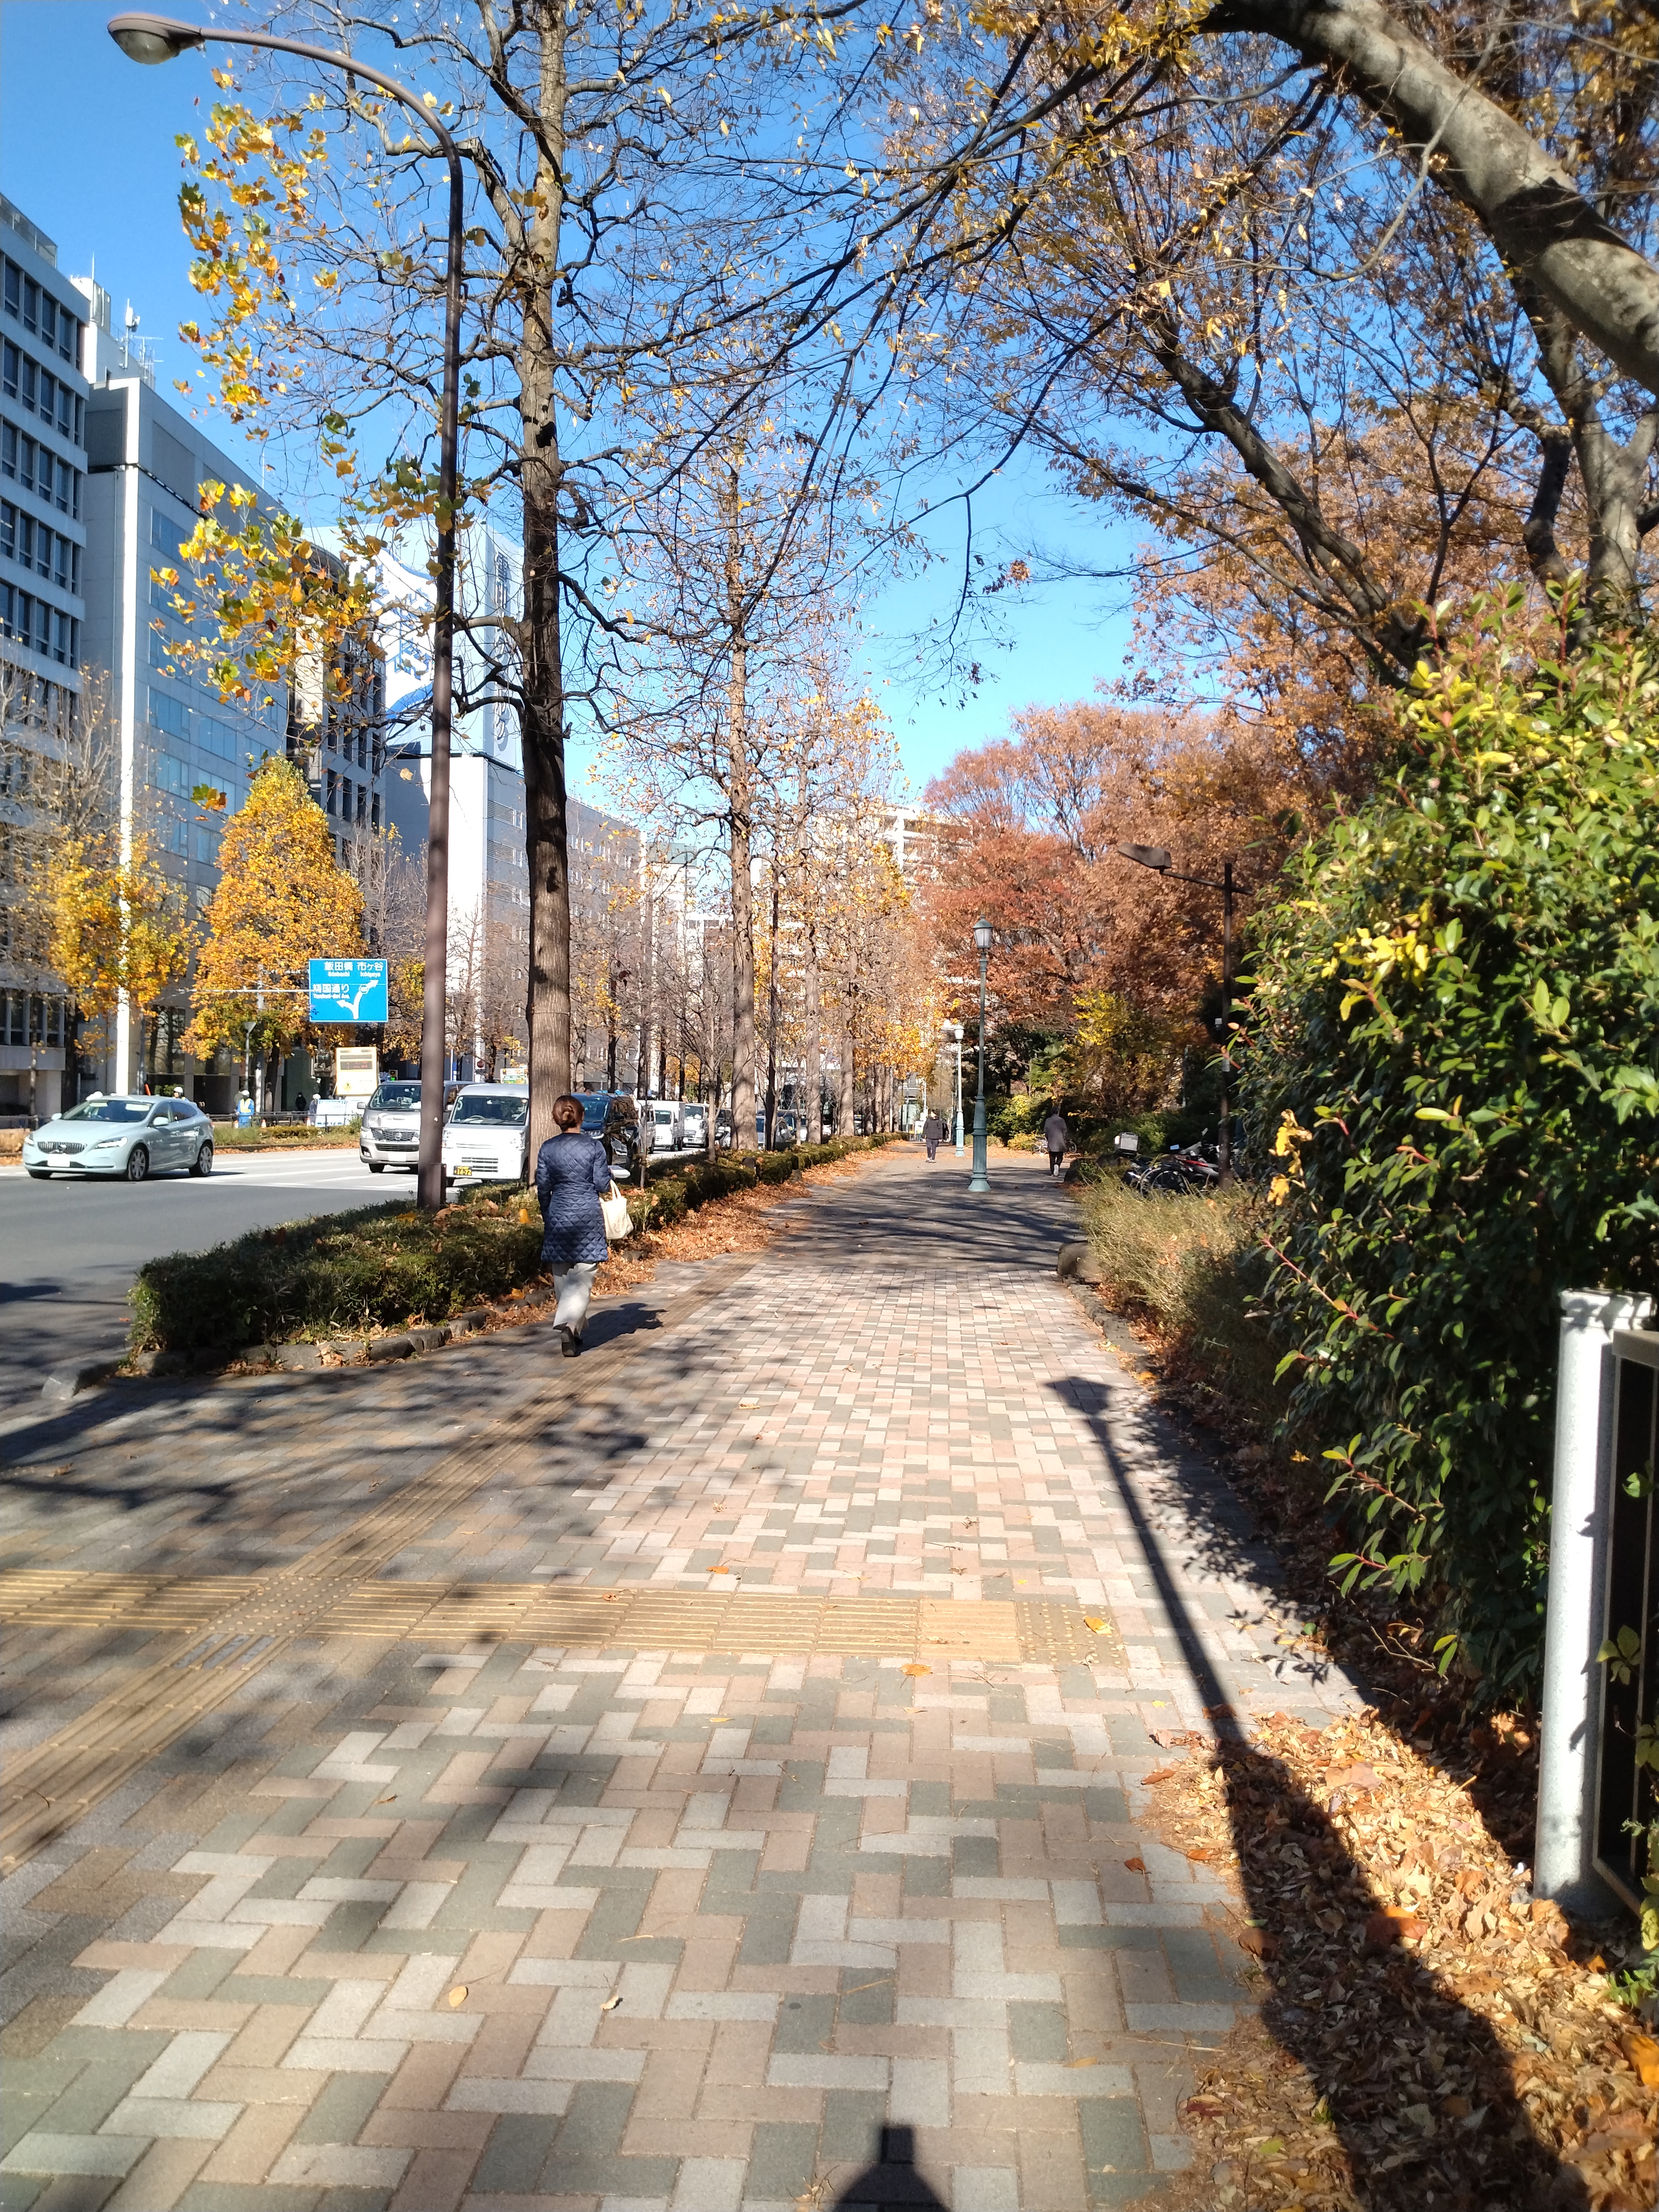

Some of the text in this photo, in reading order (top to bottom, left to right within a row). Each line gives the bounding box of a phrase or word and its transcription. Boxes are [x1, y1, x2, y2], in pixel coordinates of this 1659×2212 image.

[324, 961, 353, 971] 飯田橋
[313, 984, 349, 993] 靖国通り
